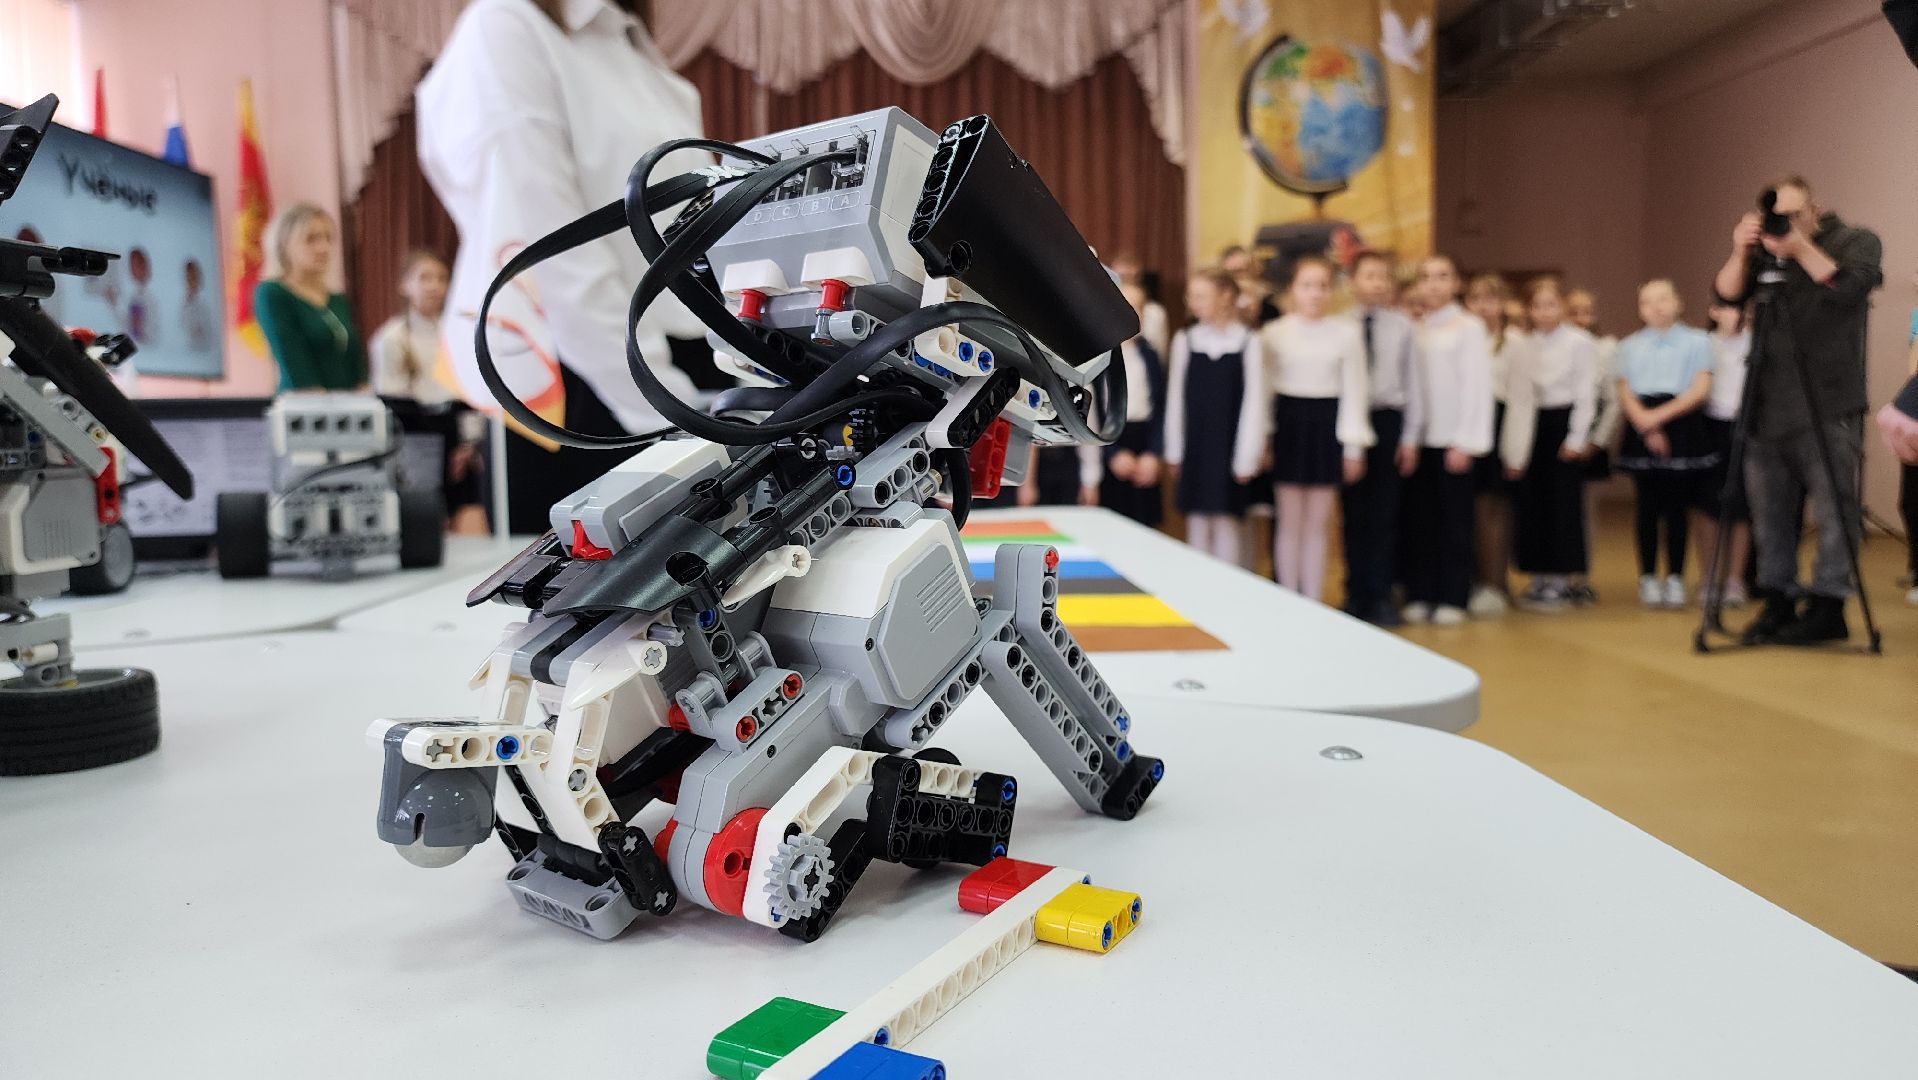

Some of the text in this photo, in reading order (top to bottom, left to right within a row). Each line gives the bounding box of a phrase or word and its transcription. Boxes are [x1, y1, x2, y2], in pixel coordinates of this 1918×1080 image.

[782, 206, 790, 216] C
[811, 201, 819, 211] B
[841, 195, 850, 207] A
